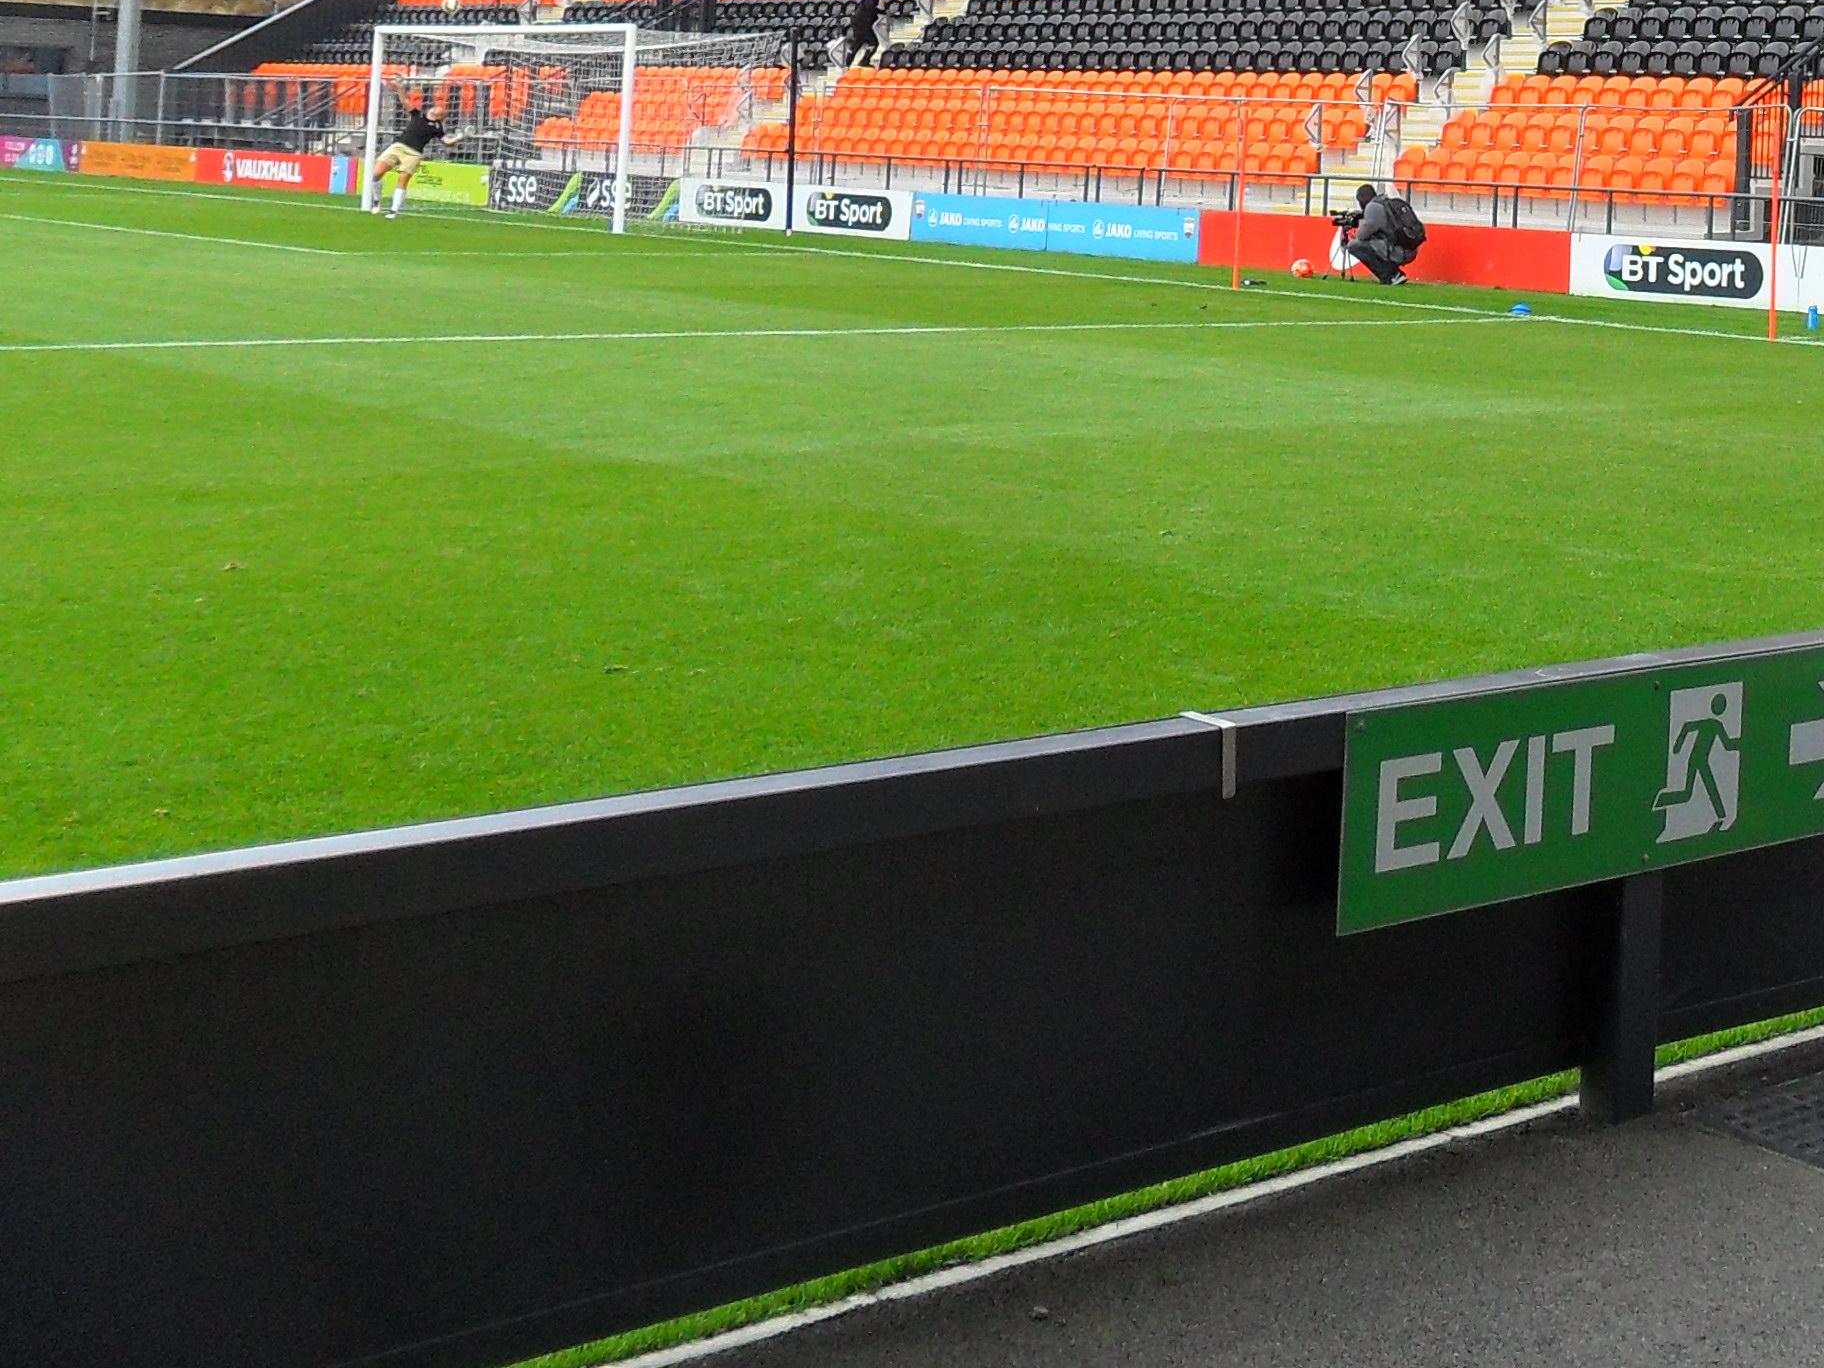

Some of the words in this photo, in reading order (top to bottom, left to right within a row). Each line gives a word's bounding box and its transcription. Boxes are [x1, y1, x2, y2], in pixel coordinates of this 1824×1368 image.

[236, 158, 303, 183] VAUXHALL
[507, 175, 537, 203] sse
[703, 191, 724, 212] BT
[726, 190, 764, 217] Sport
[815, 199, 839, 220] BT
[839, 198, 883, 226] Sport
[1020, 217, 1045, 232] JAKO
[1105, 223, 1132, 239] JAKO
[1621, 254, 1664, 282] BT
[1667, 253, 1745, 291] Sport
[1375, 724, 1615, 874] EXIT
